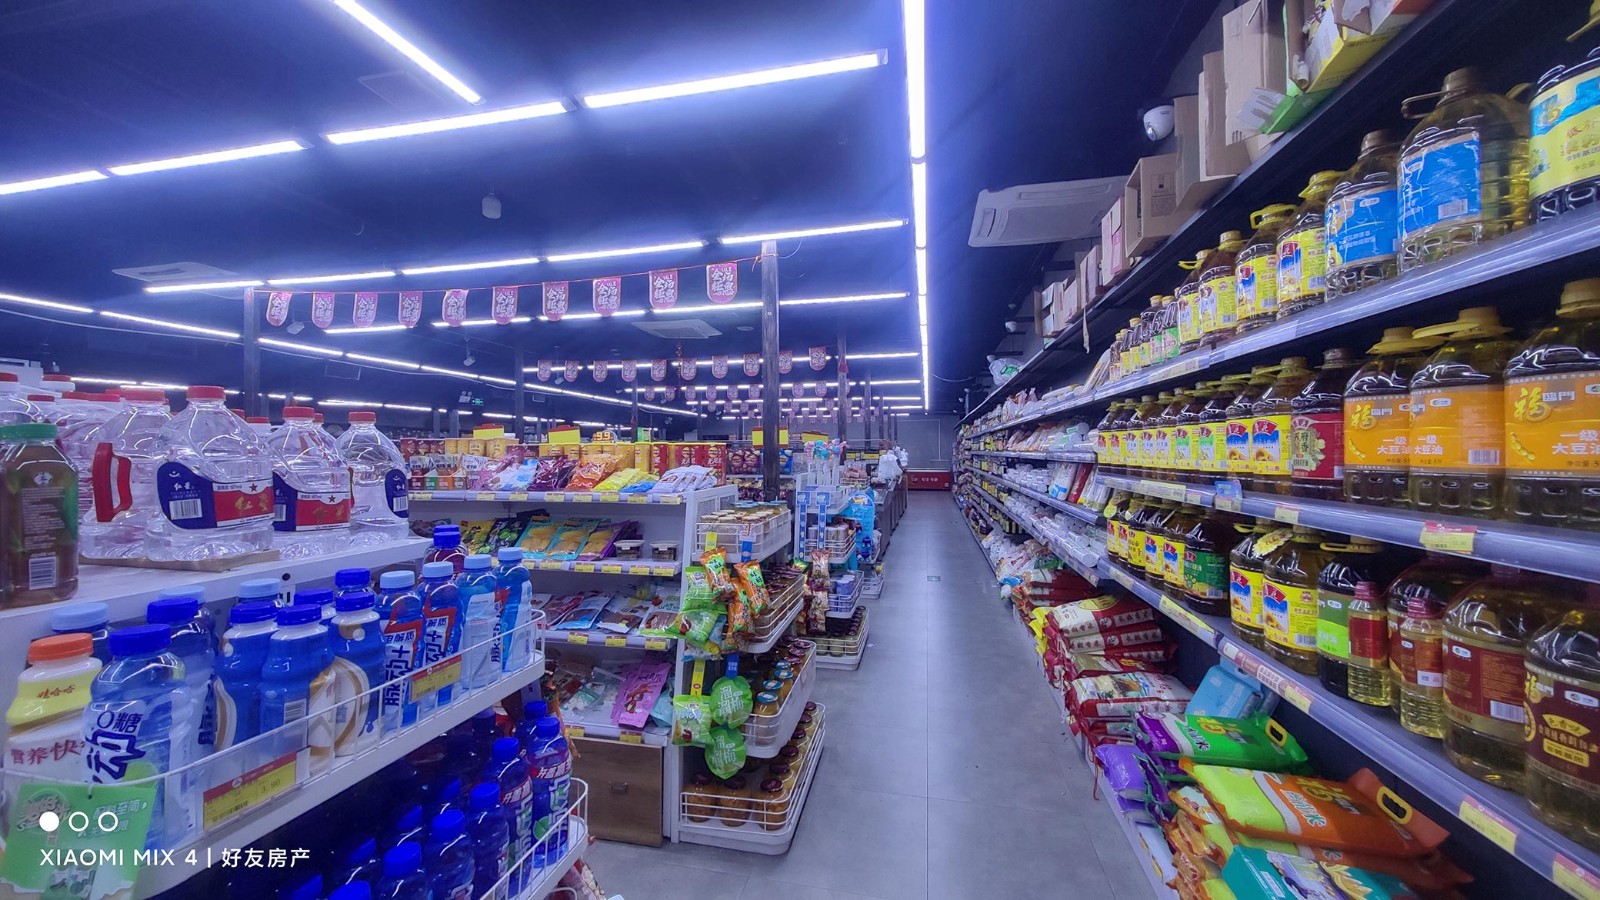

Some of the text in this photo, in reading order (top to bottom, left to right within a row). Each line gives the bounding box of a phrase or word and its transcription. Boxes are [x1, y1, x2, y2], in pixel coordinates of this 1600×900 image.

[1417, 434, 1437, 444] 一级
[1560, 429, 1598, 441] 一级
[1382, 436, 1407, 445] 一级
[1377, 445, 1411, 455] 大豆油
[1414, 445, 1443, 455] 大豆油
[1552, 443, 1600, 455] 大豆油
[37, 685, 76, 699] 娃哈哈
